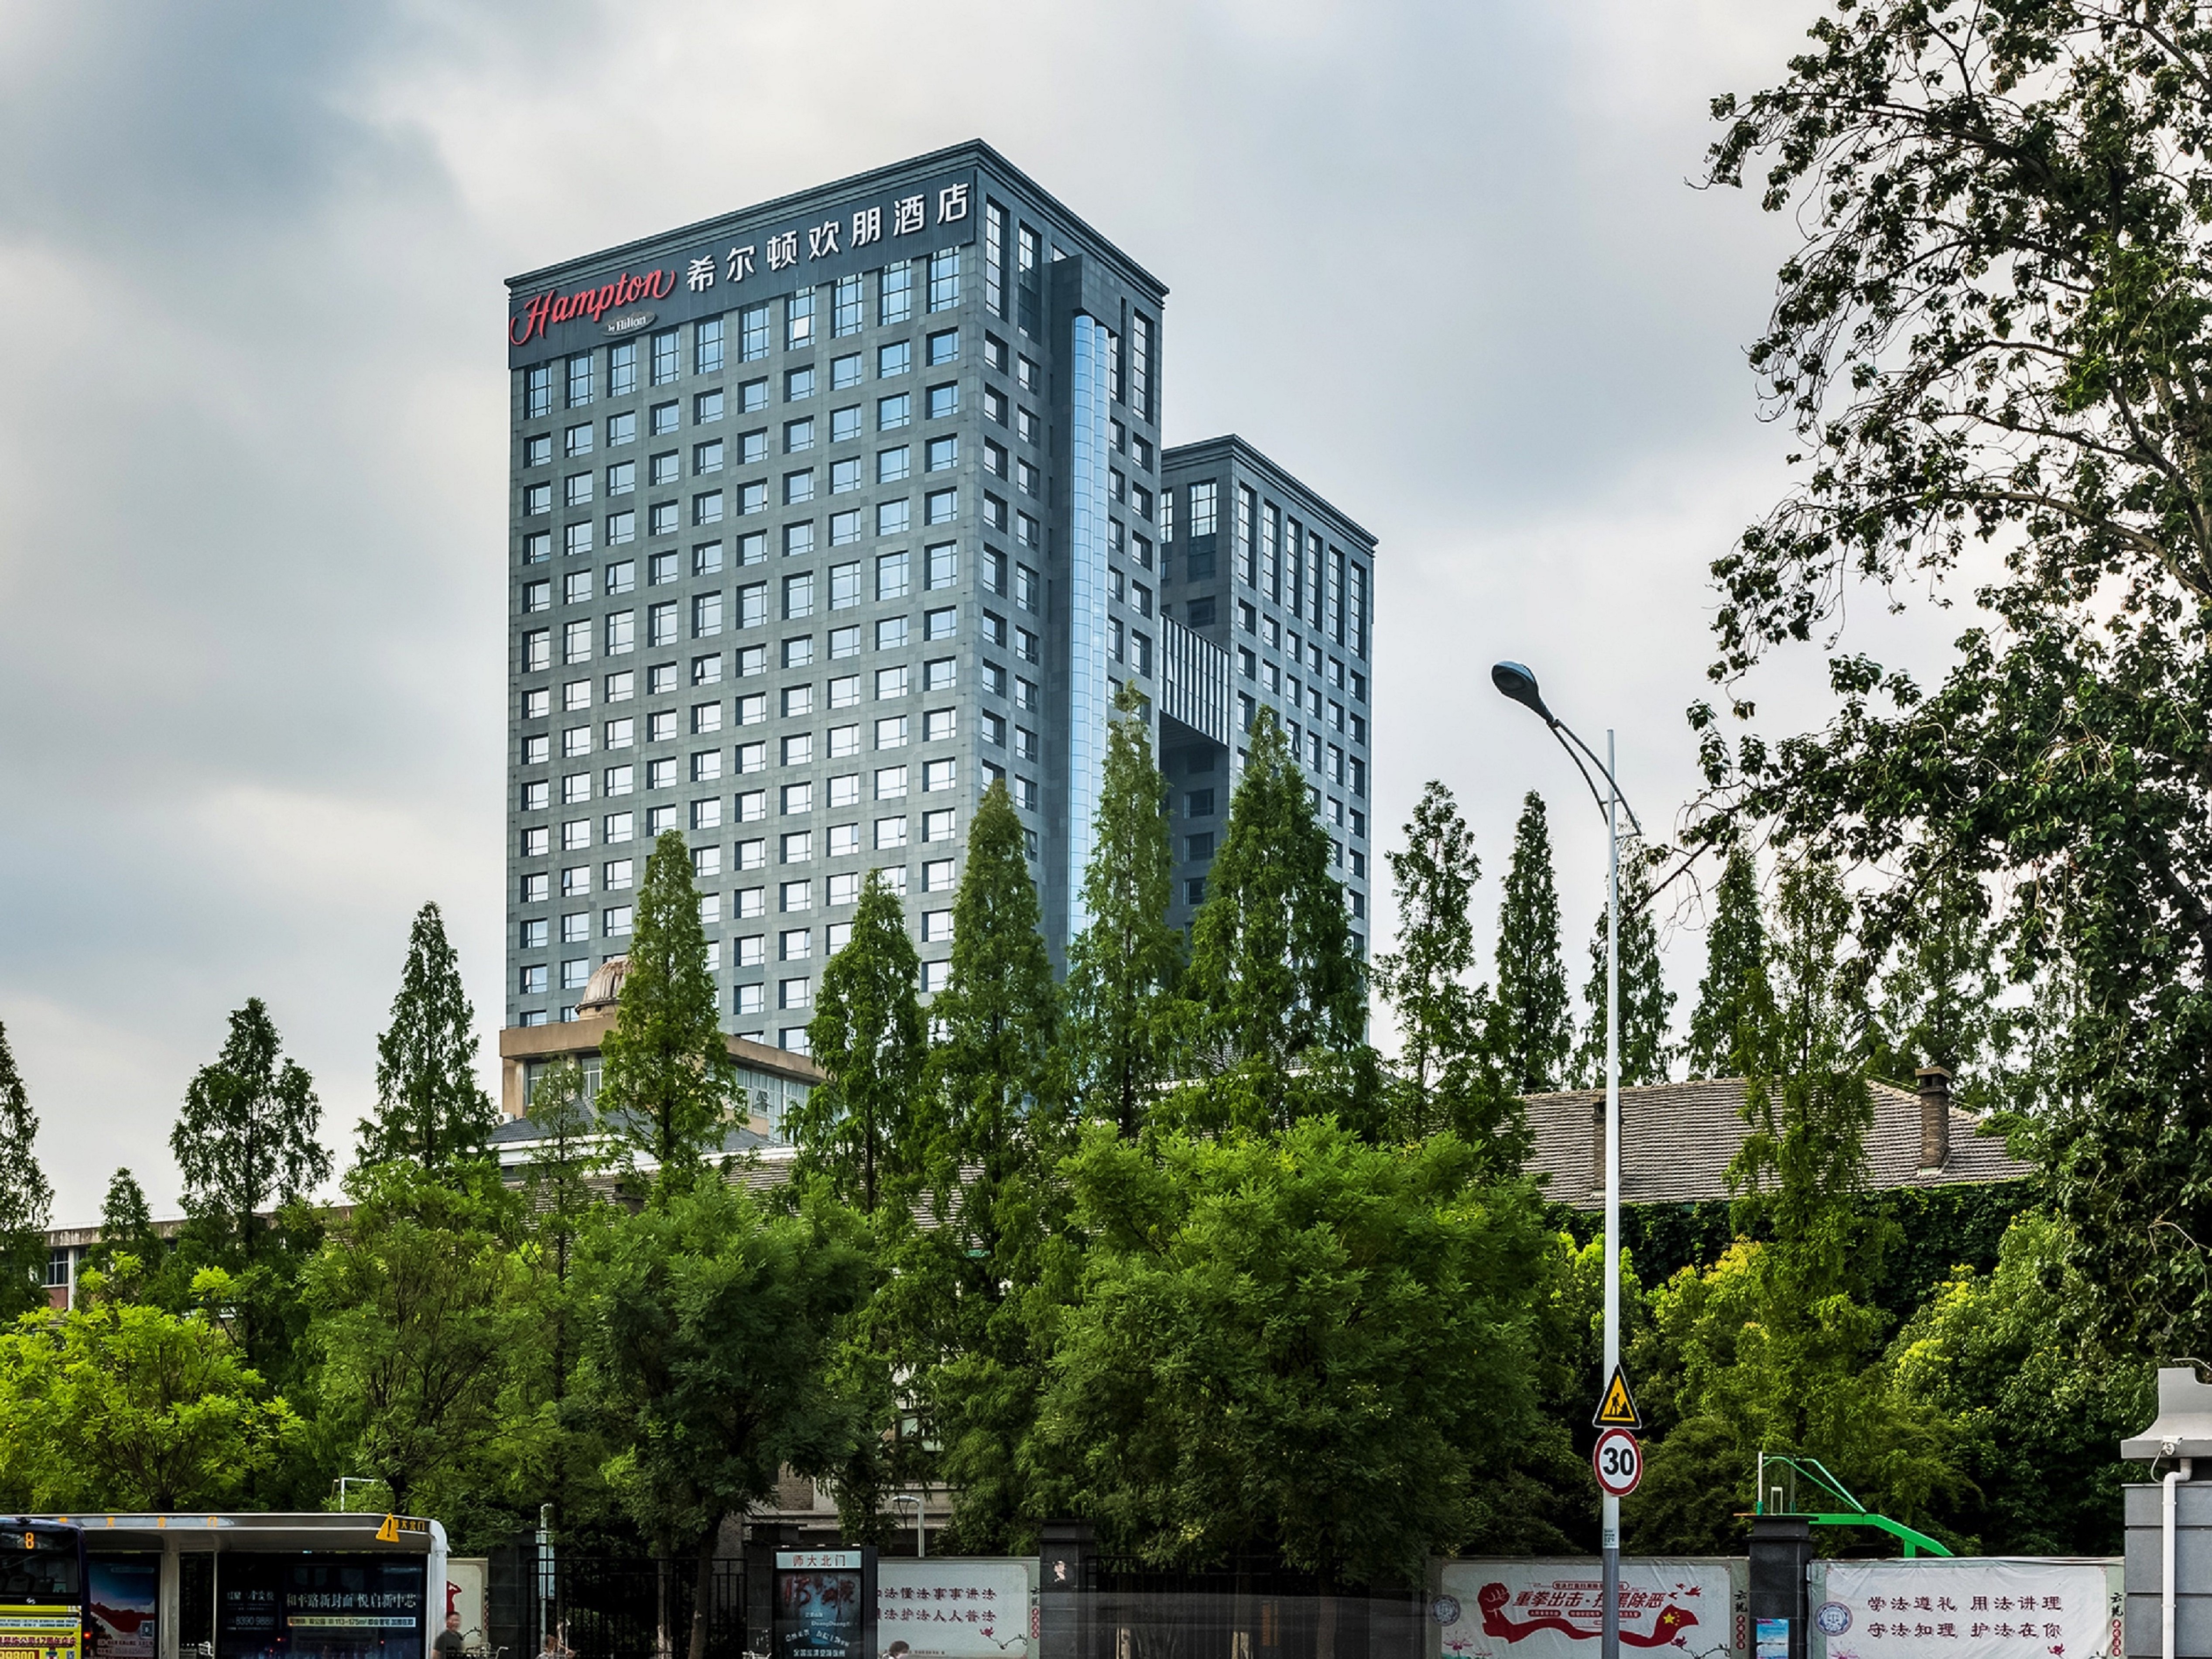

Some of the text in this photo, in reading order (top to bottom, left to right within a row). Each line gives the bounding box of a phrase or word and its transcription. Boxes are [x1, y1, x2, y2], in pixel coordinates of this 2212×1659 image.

[687, 182, 969, 293] 希尔顿欢朋酒店
[510, 269, 676, 345] Hampton
[616, 316, 646, 331] Hilton
[1603, 1447, 1634, 1476] 30
[25, 1532, 34, 1549] 8
[793, 1555, 846, 1566] 师大北门
[1970, 1596, 2063, 1611] 用法讲理
[877, 1608, 996, 1622] 法护法人人普法
[1868, 1622, 2061, 1638] 守法知理 护法在你
